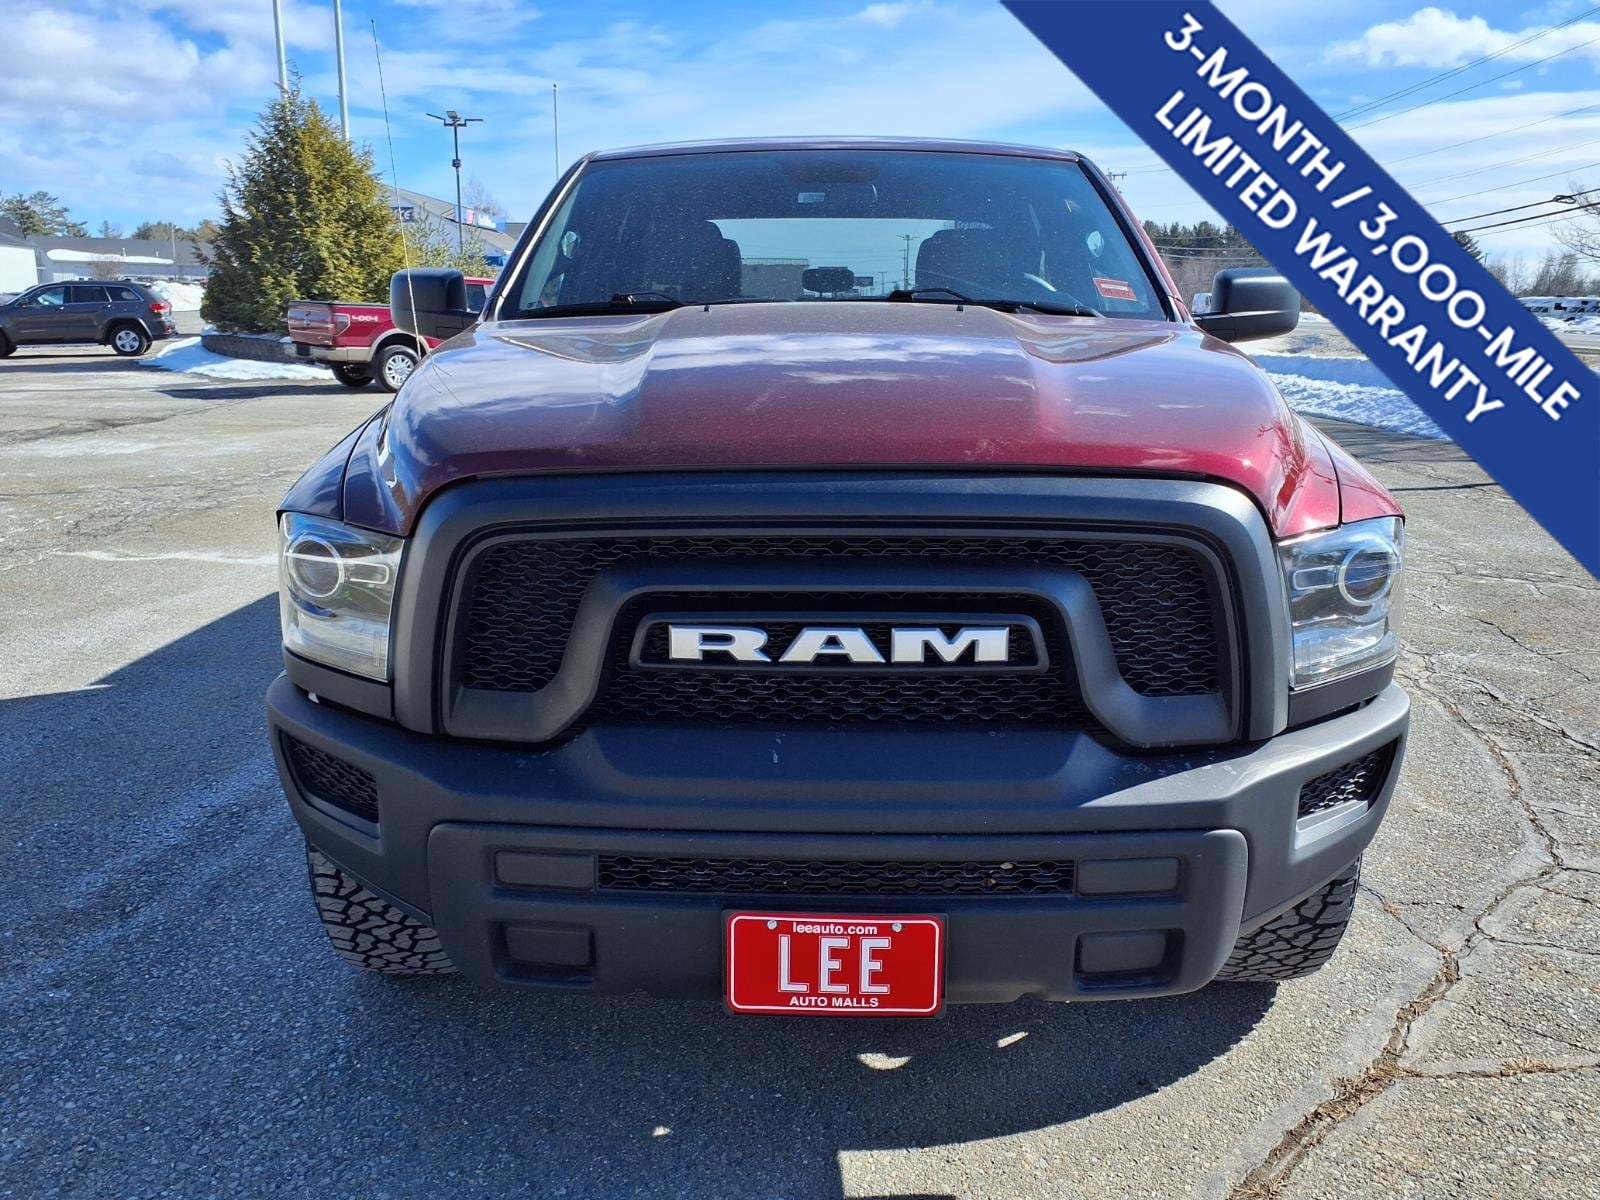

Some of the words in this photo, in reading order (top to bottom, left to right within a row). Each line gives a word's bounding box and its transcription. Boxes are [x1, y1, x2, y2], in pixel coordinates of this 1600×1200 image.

[668, 625, 1010, 663] RAM
[792, 921, 878, 935] leeauto.com
[778, 934, 892, 994] LEE
[789, 996, 828, 1007] AUTO
[831, 997, 879, 1008] MALLS
